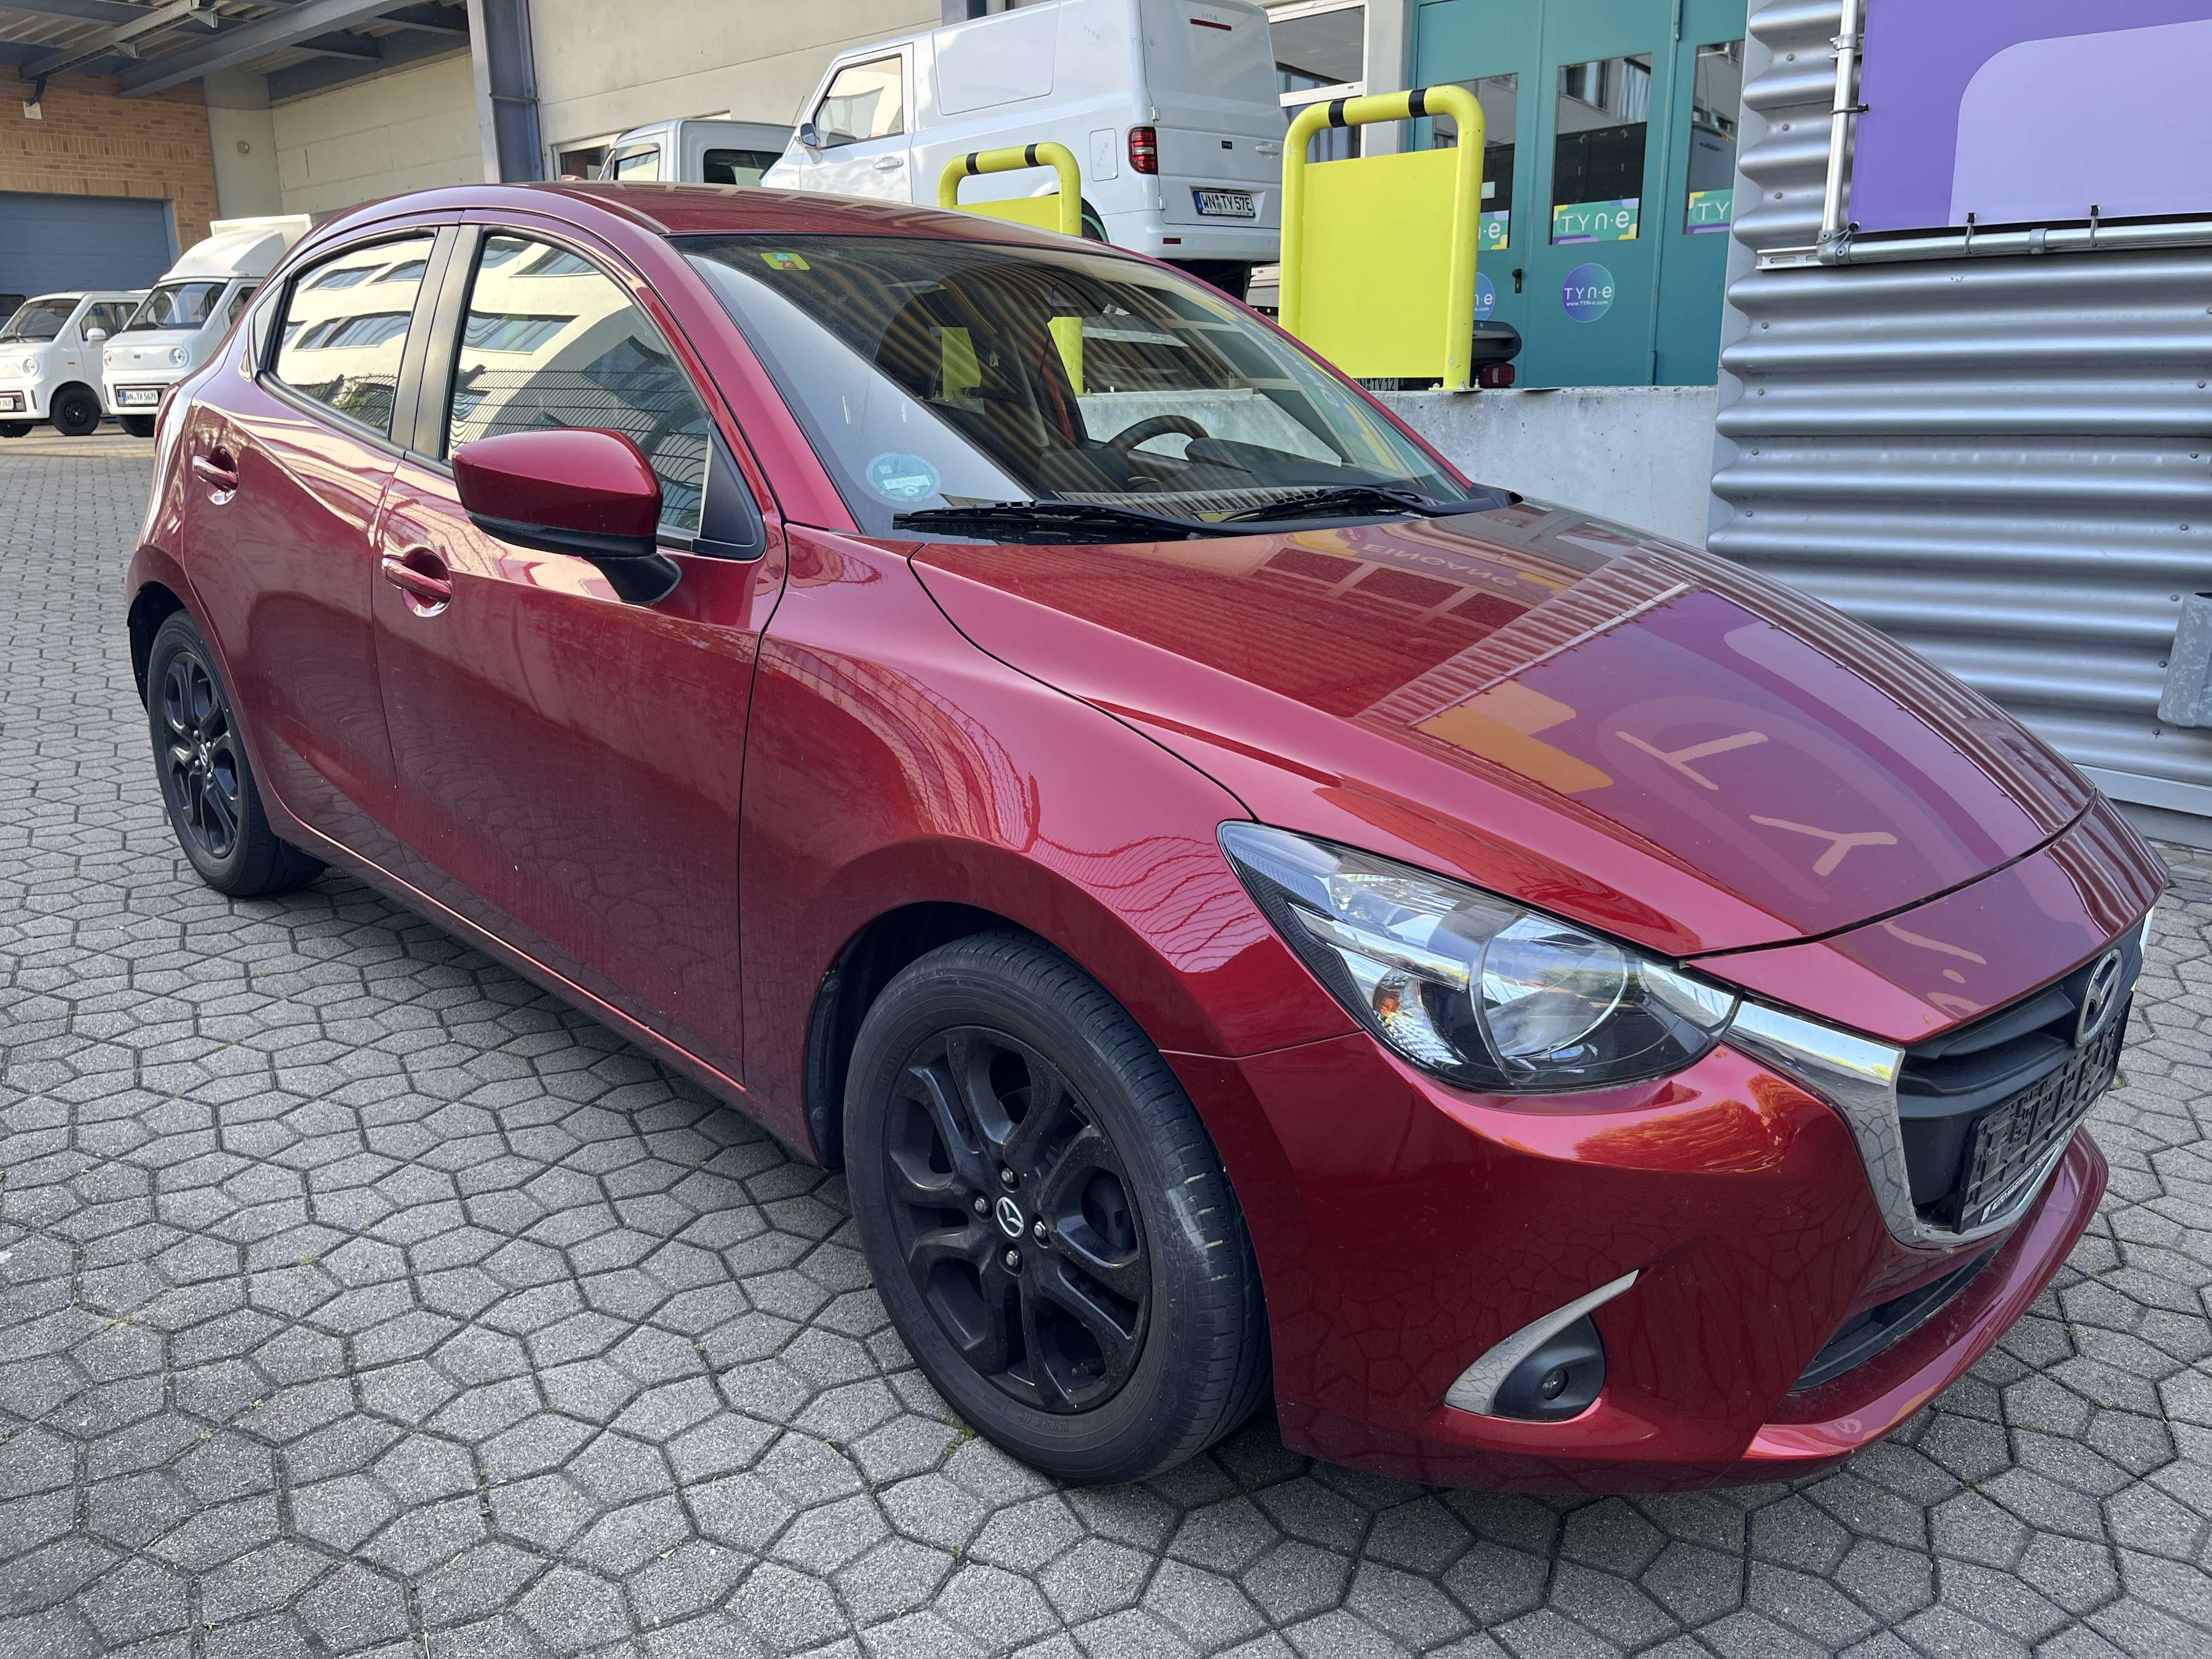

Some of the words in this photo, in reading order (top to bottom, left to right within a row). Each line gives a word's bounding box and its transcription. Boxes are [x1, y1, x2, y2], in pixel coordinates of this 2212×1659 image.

[1201, 194, 1216, 209] WN
[1220, 195, 1233, 210] TY
[1234, 196, 1252, 211] 57E
